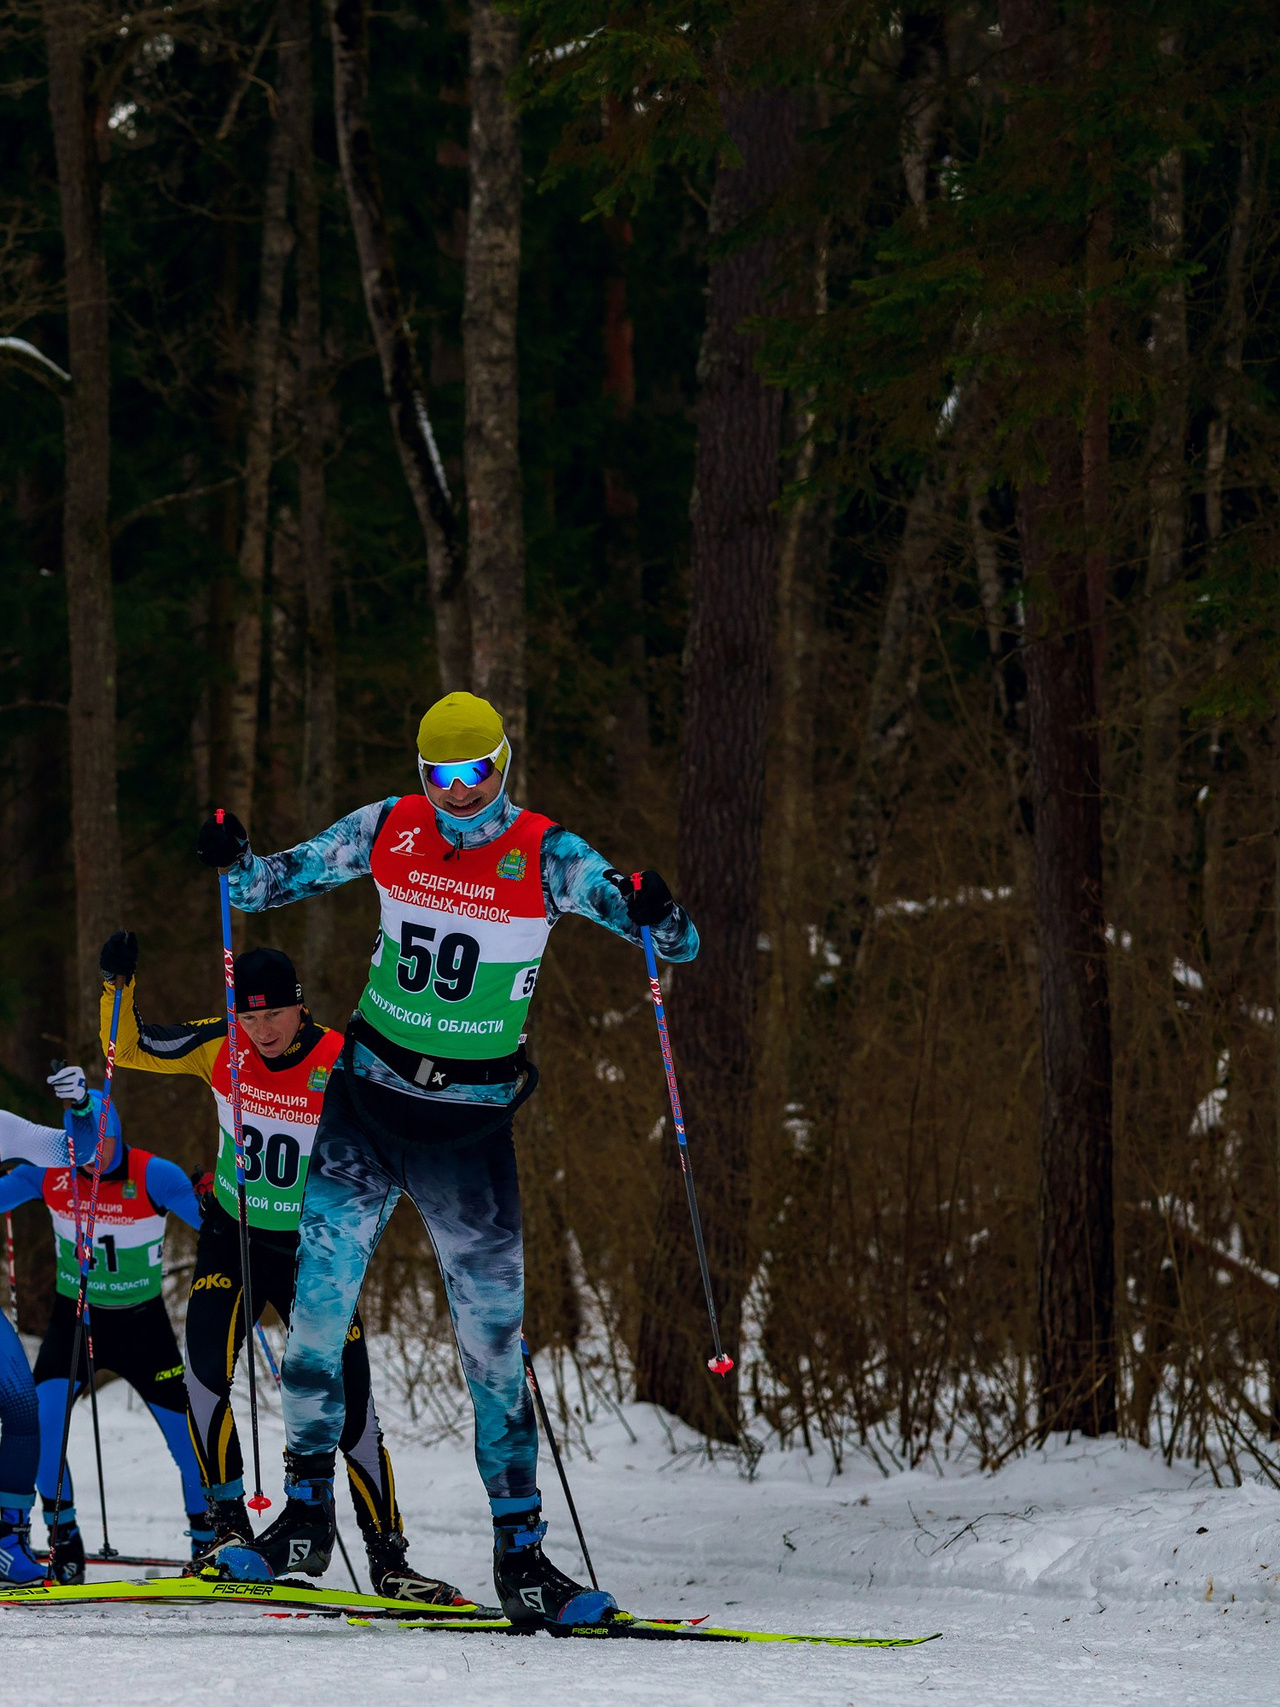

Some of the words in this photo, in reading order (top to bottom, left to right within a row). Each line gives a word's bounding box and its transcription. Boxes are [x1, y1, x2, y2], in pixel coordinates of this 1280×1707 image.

[408, 869, 496, 901] ФЕДЕРАЦИЯ
[389, 884, 454, 914] ЛЫЖНЫХ
[458, 901, 510, 923] ГОНОК
[396, 920, 481, 1002] 59
[437, 1018, 504, 1034] ОБЛАСТИ
[226, 1093, 276, 1118] ЛЖНЫХ
[279, 1108, 321, 1125] ГОНОК
[239, 1082, 308, 1108] ФЕДЕРАЦИЯ
[241, 1124, 301, 1189] 30
[109, 1278, 150, 1292] ОБЛАСТИ
[212, 1583, 274, 1596] FISCHER
[571, 1627, 609, 1635] FISCHER
